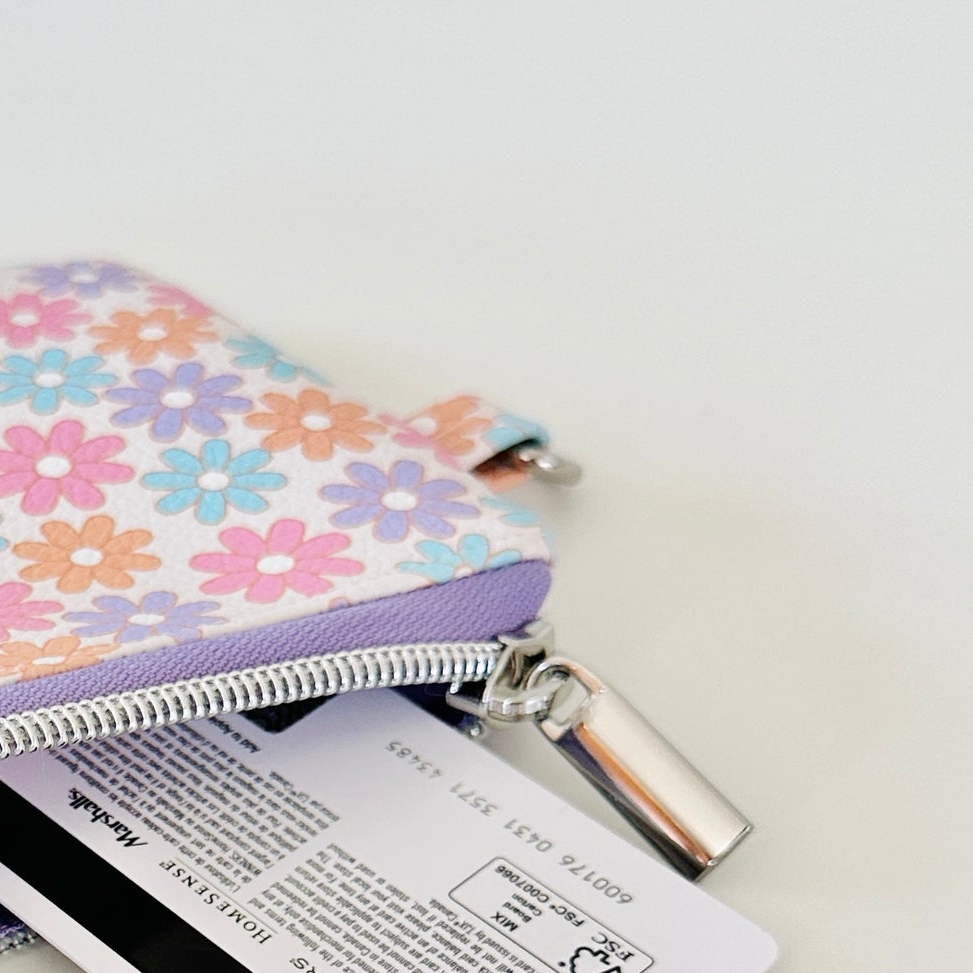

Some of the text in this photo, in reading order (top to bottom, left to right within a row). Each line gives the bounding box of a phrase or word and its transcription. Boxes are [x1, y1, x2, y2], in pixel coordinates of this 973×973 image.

[448, 781, 498, 817] 3571
[503, 817, 553, 853] 0431
[494, 864, 550, 904] C007066
[558, 854, 633, 904] 600176
[501, 900, 532, 924] Board
[510, 892, 543, 917] Carton
[402, 912, 433, 933] please
[424, 913, 438, 923] if
[490, 910, 519, 932] MIX
[378, 926, 411, 951] subject
[393, 921, 420, 941] active
[433, 919, 471, 945] replaced
[472, 929, 487, 942] by
[376, 941, 391, 954] be
[415, 936, 430, 948] an
[423, 945, 440, 955] of
[468, 943, 483, 956] be
[480, 936, 511, 959] issued
[590, 932, 635, 962] FSC
[367, 951, 380, 962] in
[385, 948, 416, 971] cannot
[406, 947, 424, 960] are
[456, 951, 480, 968] card
[479, 951, 499, 965] not
[506, 953, 519, 964] is
[417, 956, 441, 973] card
